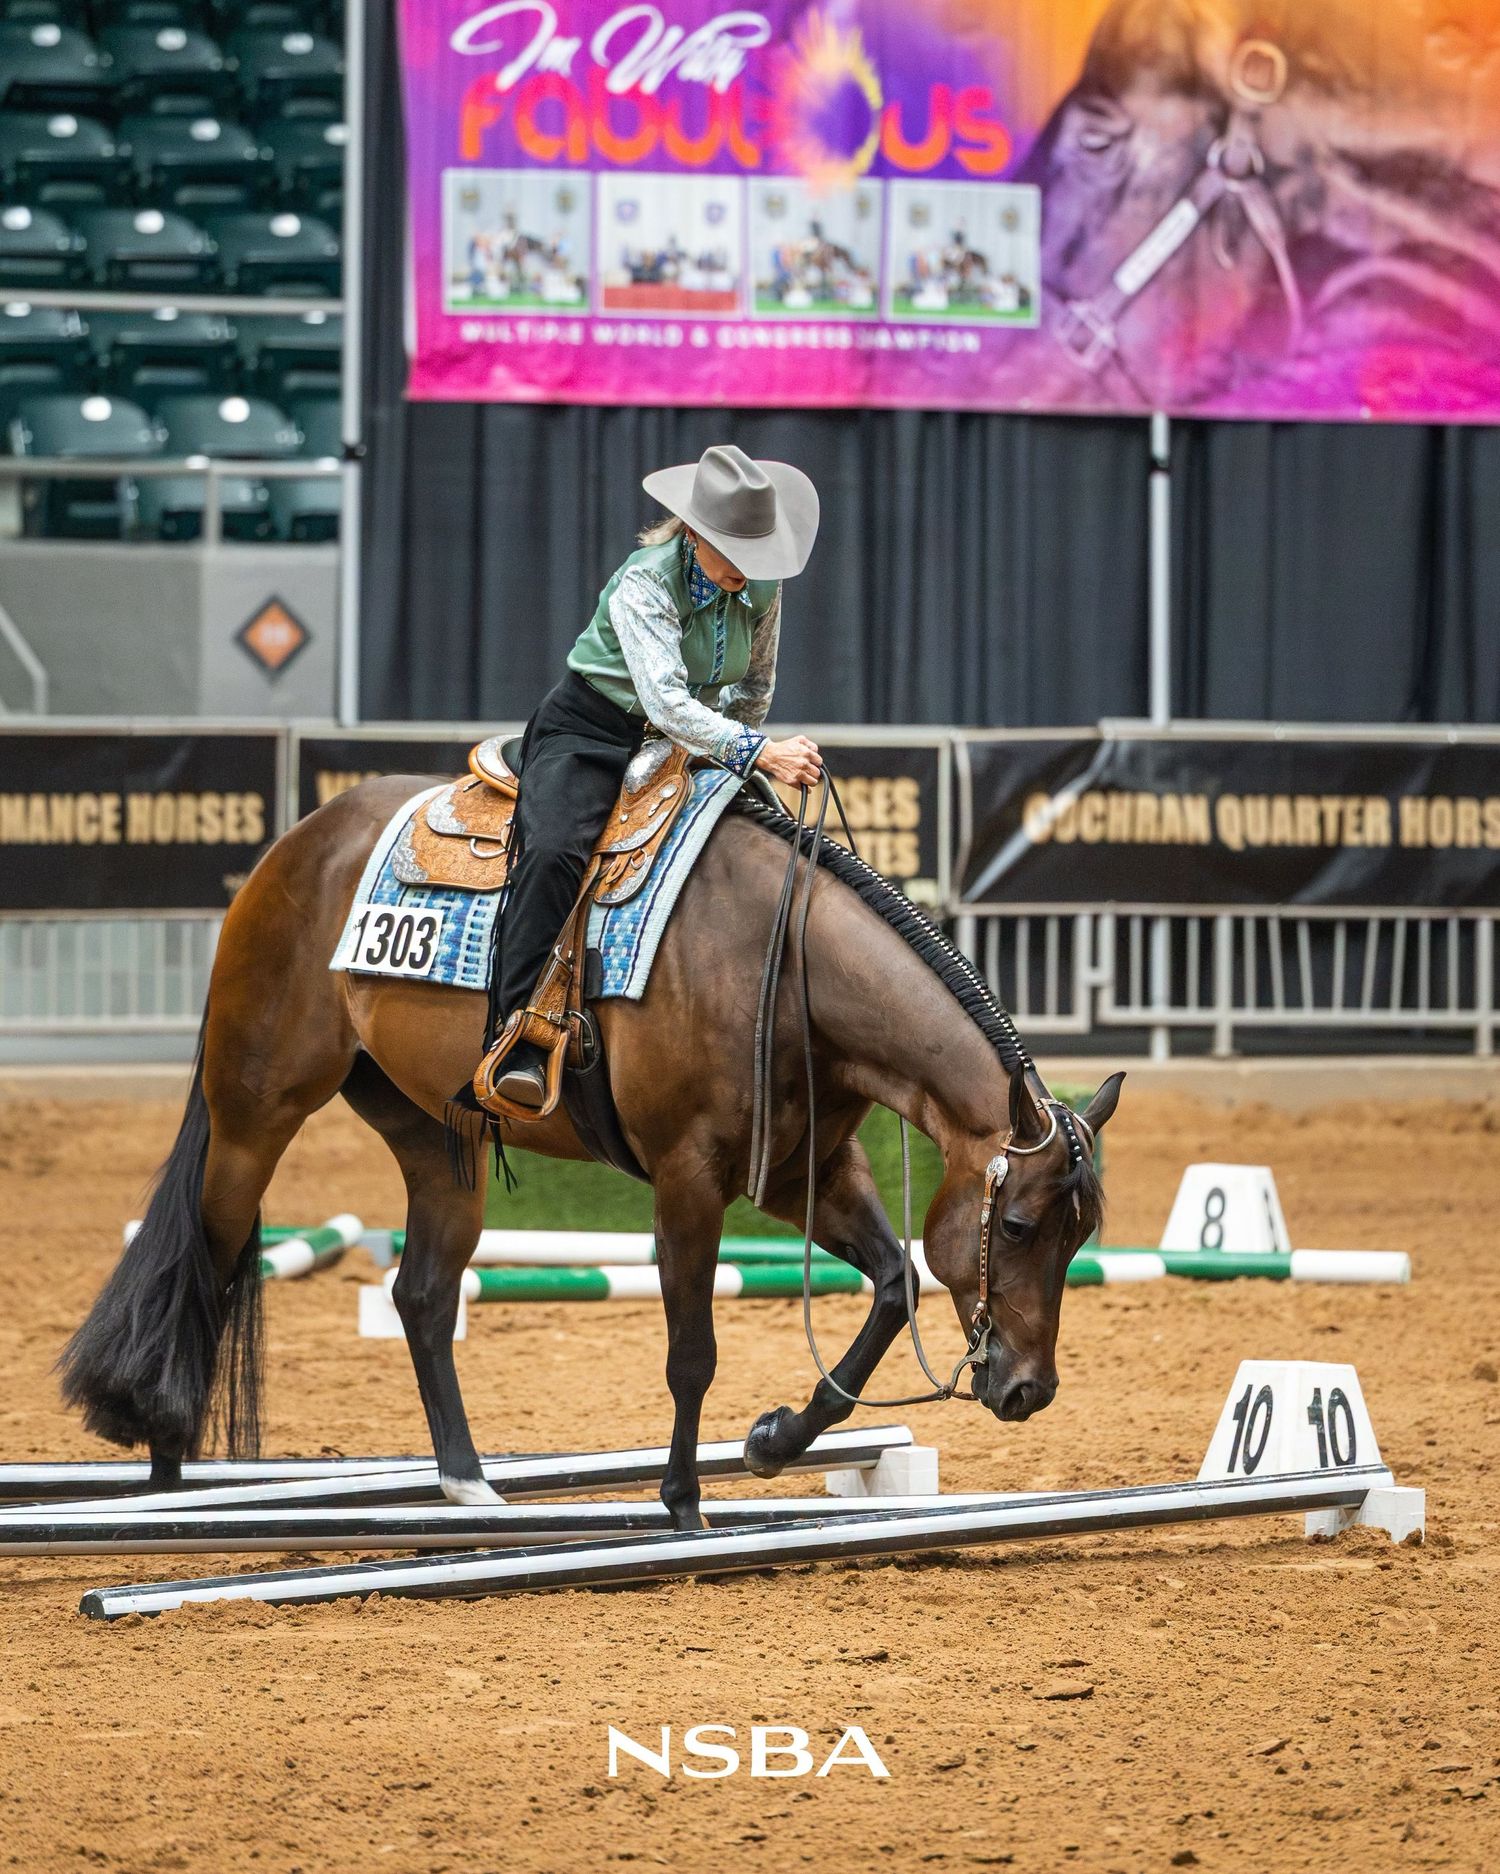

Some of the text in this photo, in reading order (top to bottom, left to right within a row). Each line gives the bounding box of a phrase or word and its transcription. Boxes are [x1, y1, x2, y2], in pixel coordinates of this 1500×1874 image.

[592, 324, 684, 348] WORLD
[717, 326, 851, 349] CONGRESS
[127, 792, 265, 844] HORSES
[1023, 792, 1211, 845] COCHRAN
[1215, 793, 1391, 851] QUARTER
[350, 910, 437, 970] 1303
[1200, 1187, 1226, 1251] 8
[1227, 1384, 1357, 1475] 10 10
